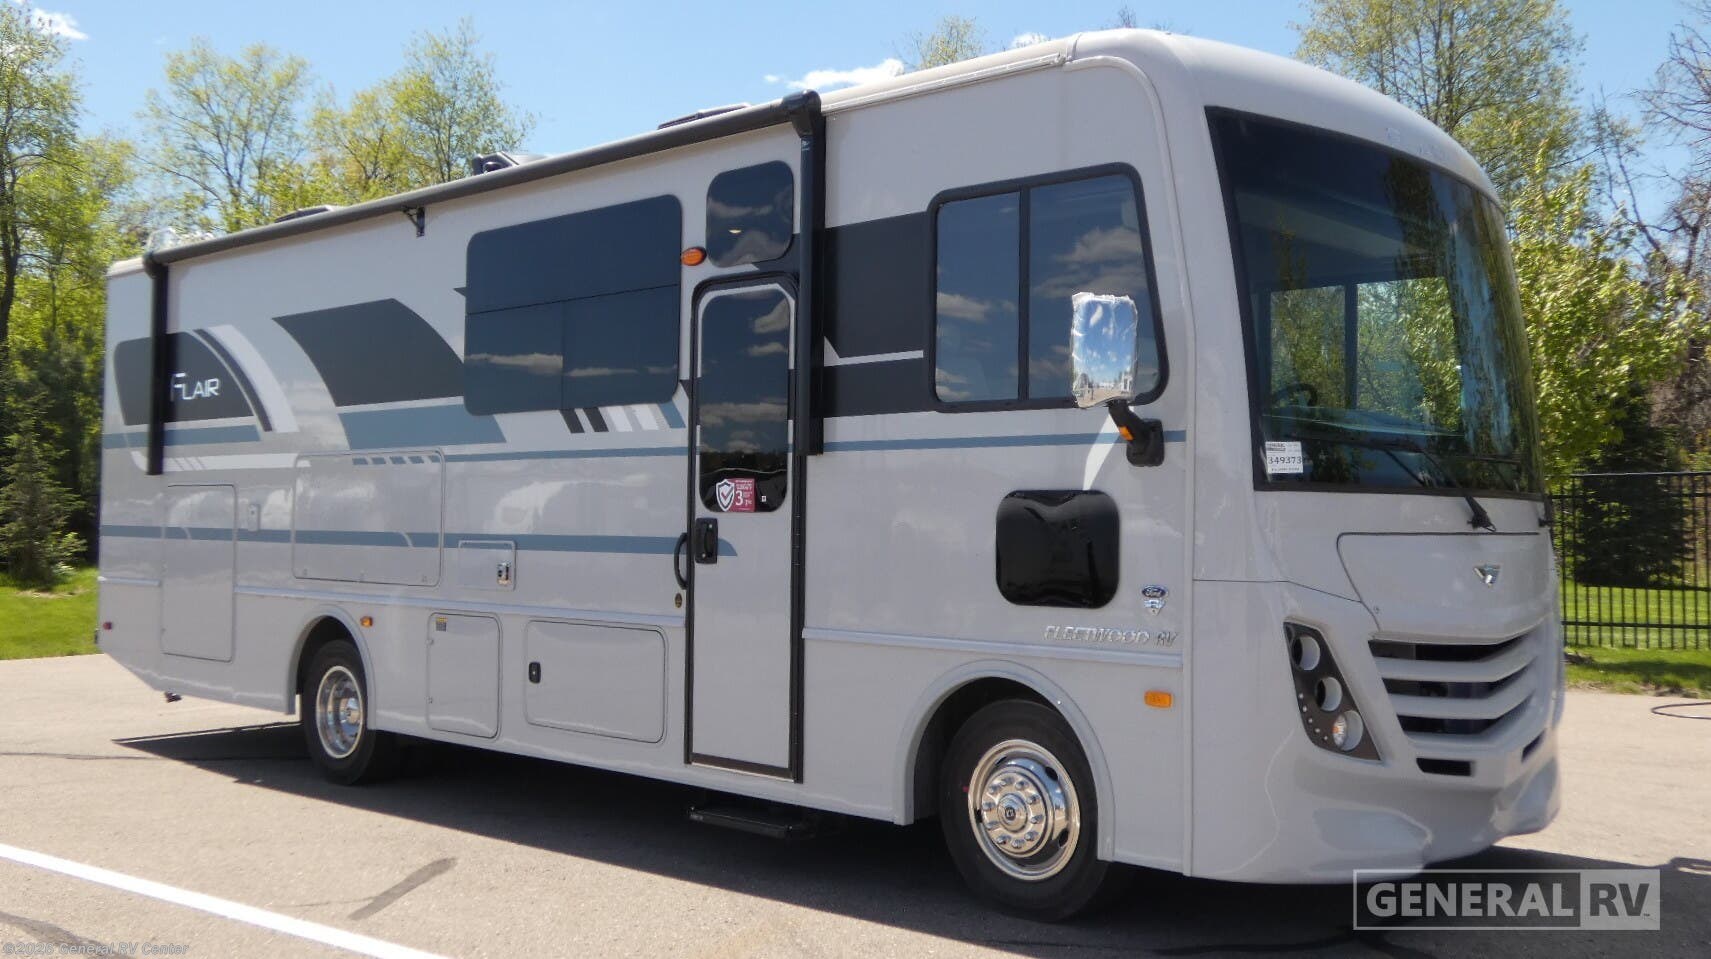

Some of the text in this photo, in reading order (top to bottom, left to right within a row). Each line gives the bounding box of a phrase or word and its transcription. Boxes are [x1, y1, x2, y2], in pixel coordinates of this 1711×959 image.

[170, 372, 219, 402] FLAIR
[1267, 456, 1302, 464] 349373
[735, 490, 744, 506] 3
